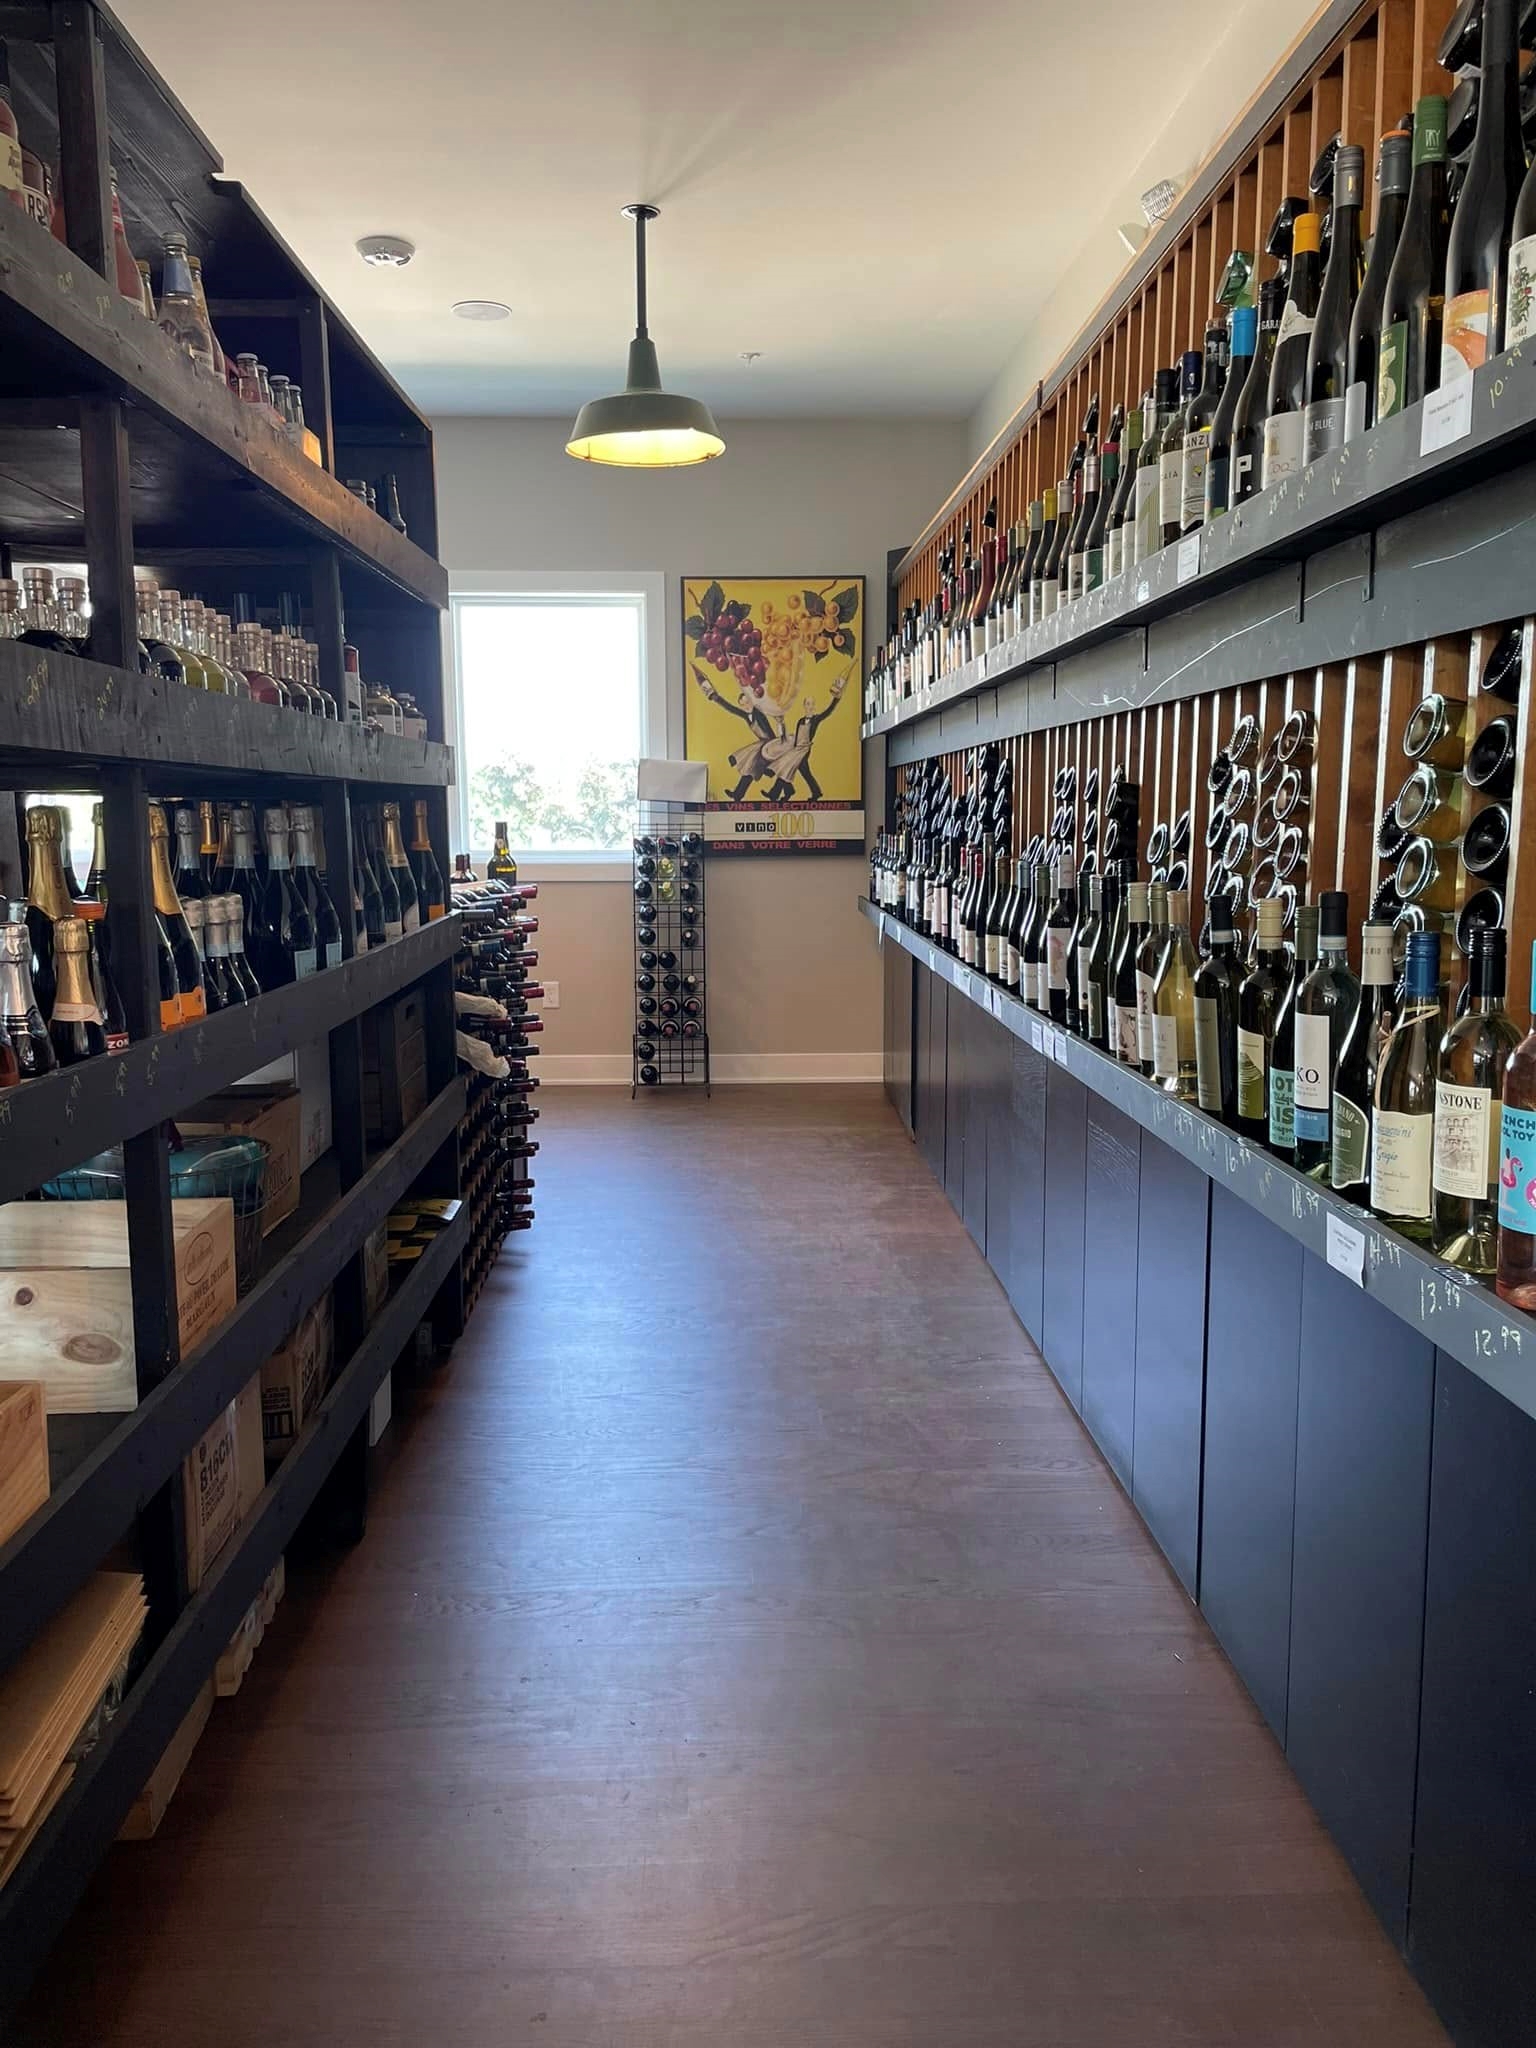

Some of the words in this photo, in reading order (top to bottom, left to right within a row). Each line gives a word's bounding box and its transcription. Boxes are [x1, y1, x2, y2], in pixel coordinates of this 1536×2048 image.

[727, 802, 754, 811] VINS
[713, 841, 745, 850] DANS
[751, 841, 791, 849] VOTRE
[797, 840, 837, 849] VERRE
[1512, 1129, 1535, 1143] TOY
[1420, 1278, 1461, 1320] 13.99
[1474, 1325, 1521, 1356] 12.99
